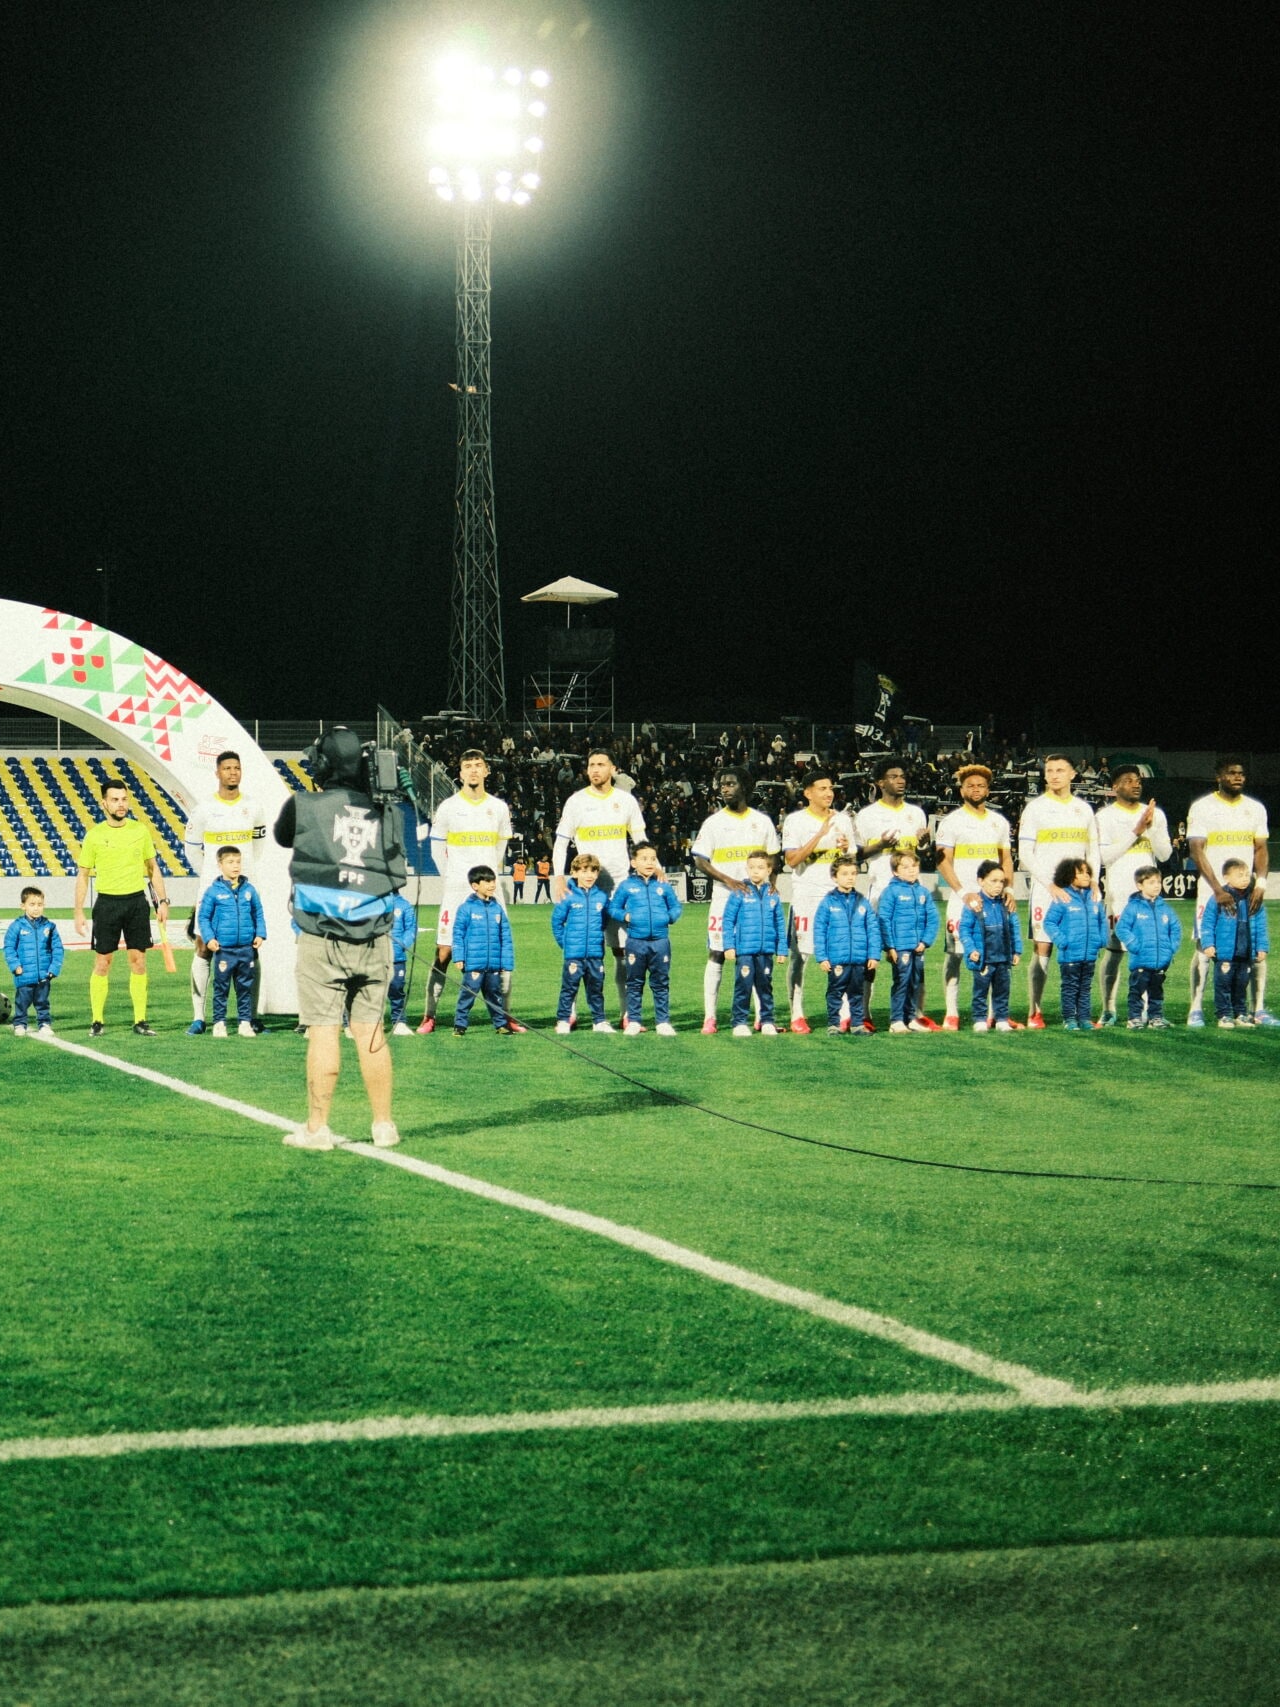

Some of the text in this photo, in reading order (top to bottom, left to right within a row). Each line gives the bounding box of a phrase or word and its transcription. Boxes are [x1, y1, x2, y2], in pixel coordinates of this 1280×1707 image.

[1061, 831, 1087, 839] ELVAS
[1226, 834, 1253, 842] ELVAS
[977, 847, 997, 855] ELVA
[338, 869, 365, 885] FPF
[440, 909, 450, 926] 4
[1034, 906, 1043, 921] 8
